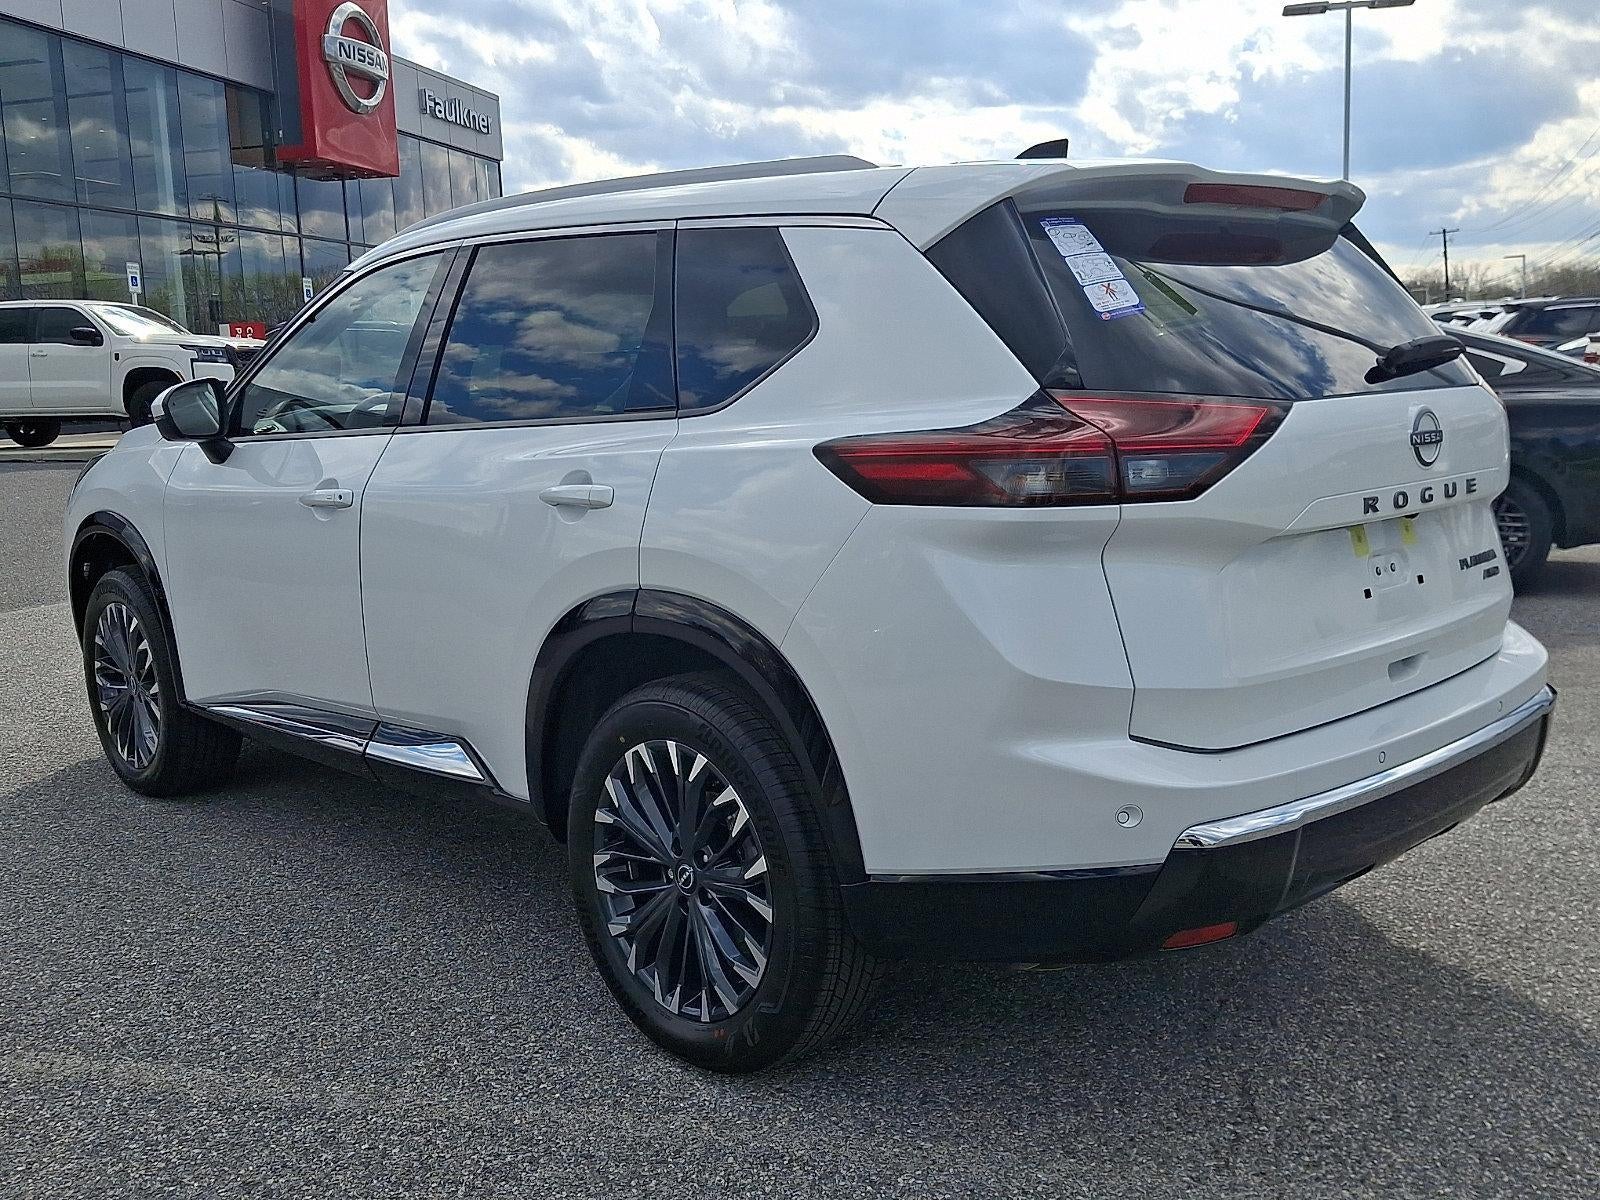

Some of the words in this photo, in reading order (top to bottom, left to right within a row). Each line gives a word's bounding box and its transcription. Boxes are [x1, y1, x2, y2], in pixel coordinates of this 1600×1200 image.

[337, 41, 388, 75] NISSAN
[420, 88, 493, 134] Faulkner
[1412, 432, 1442, 445] NISSA
[1362, 477, 1477, 514] ROGUE
